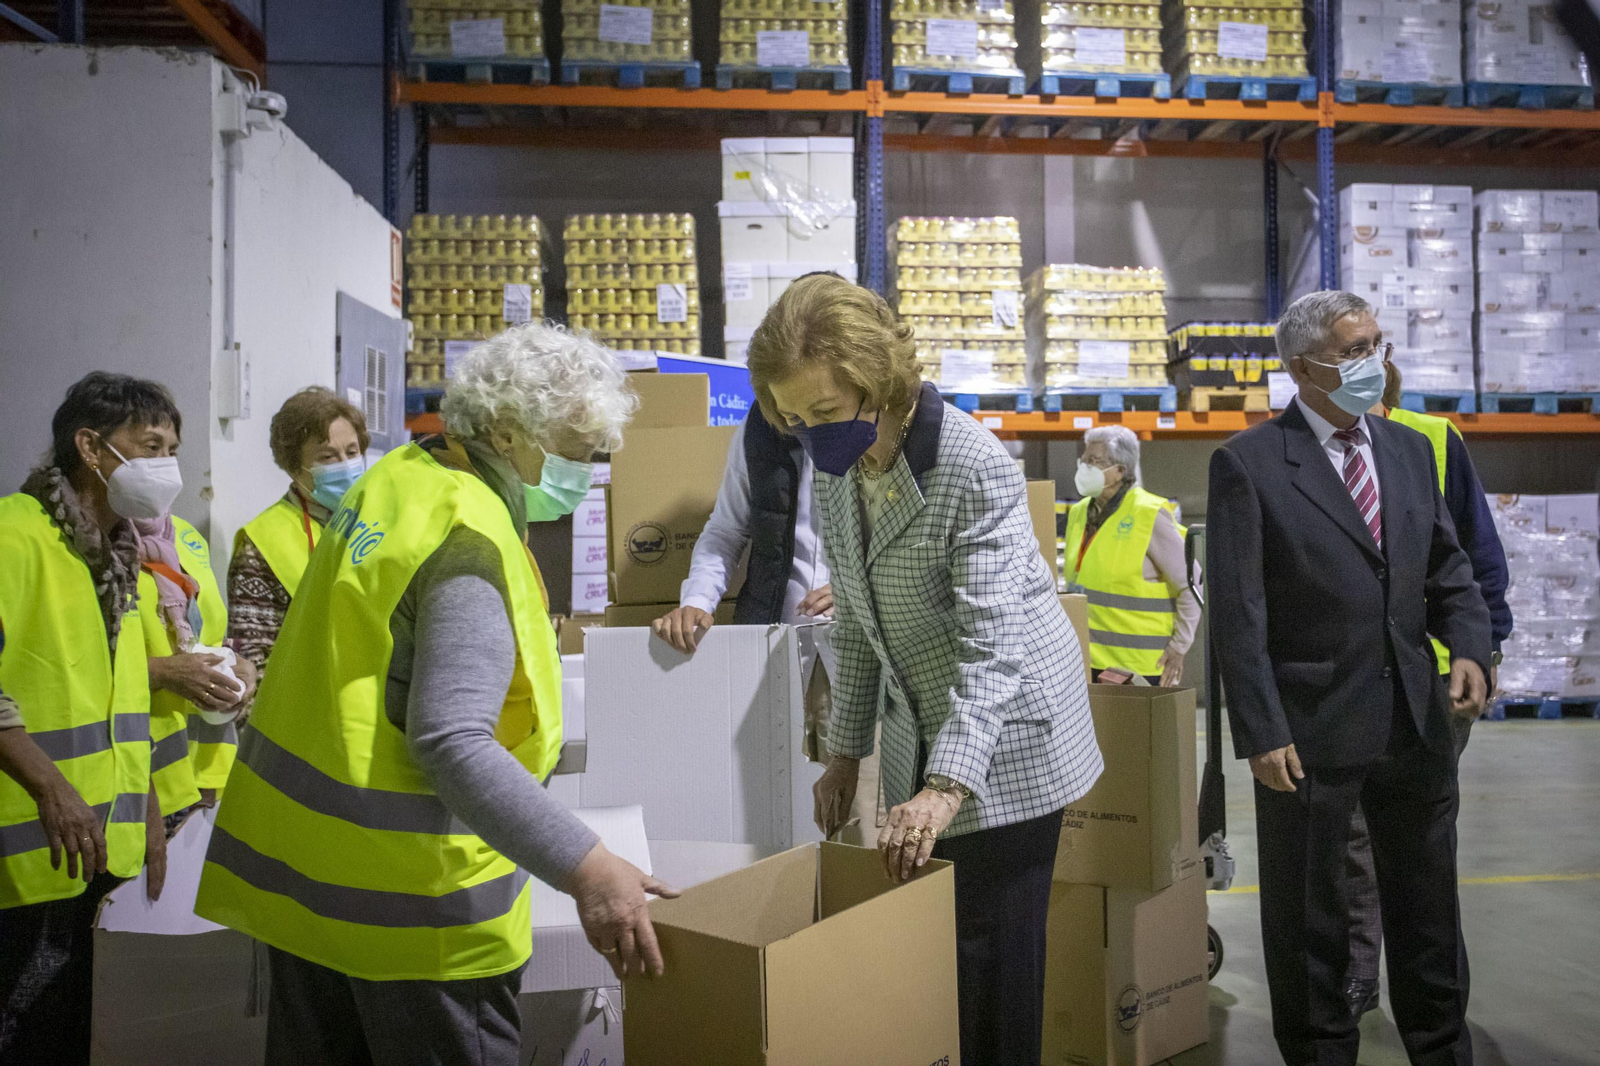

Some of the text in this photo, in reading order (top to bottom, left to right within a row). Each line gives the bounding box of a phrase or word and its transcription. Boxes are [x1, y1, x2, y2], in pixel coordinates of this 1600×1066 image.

[674, 533, 701, 541] BANC
[1077, 810, 1089, 819] DE
[1090, 811, 1138, 824] ALIMENTOS
